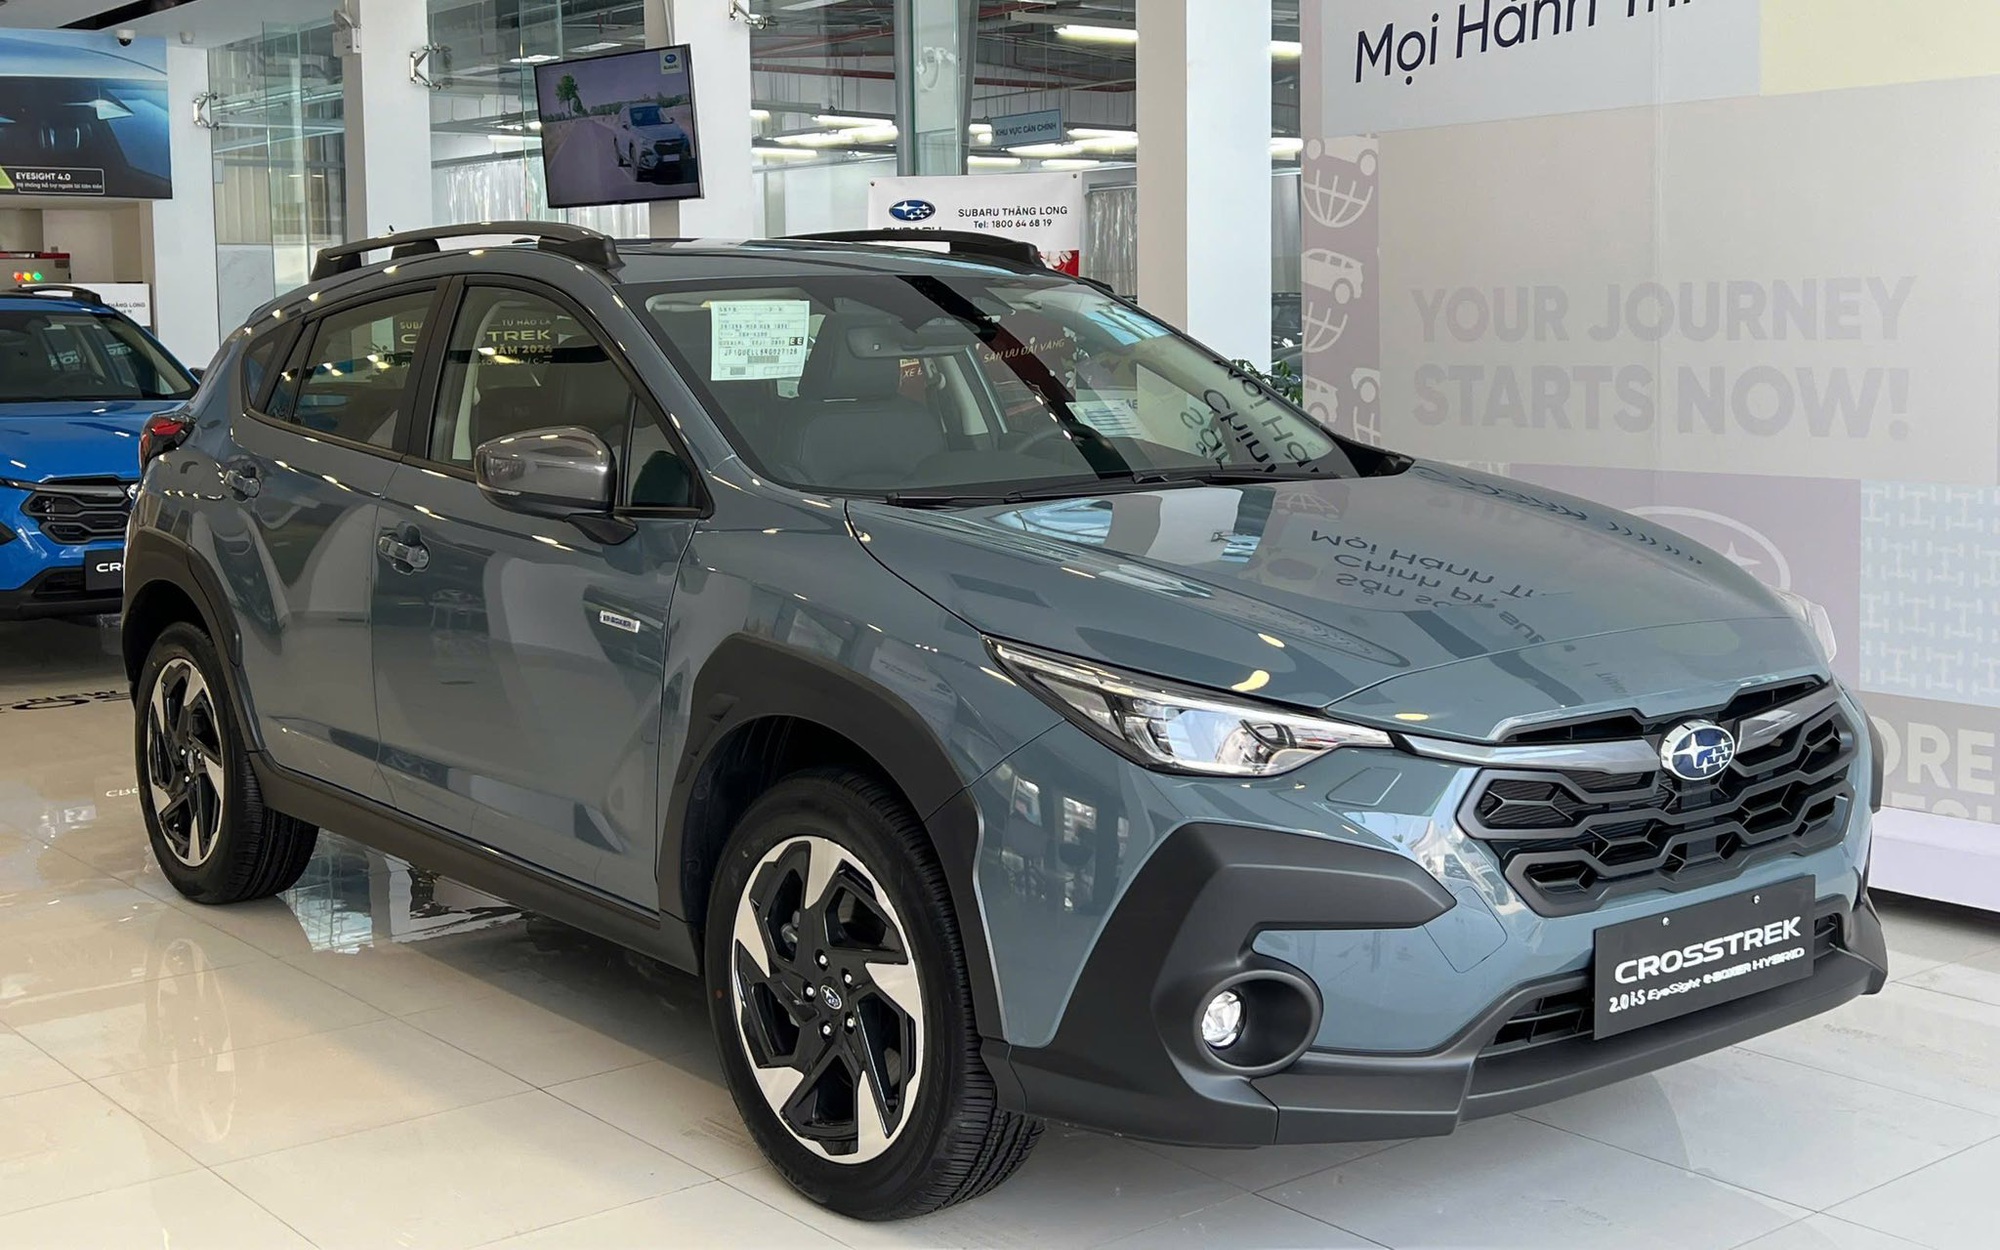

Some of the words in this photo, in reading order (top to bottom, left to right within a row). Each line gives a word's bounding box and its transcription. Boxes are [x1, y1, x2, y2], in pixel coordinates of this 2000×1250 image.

[1355, 13, 1439, 86] Mọi
[16, 172, 55, 180] EYESIGHT
[57, 173, 71, 181] 4.0
[958, 208, 999, 217] SUBARU
[1040, 206, 1068, 215] LONG
[973, 220, 988, 228] Tel:
[991, 219, 1013, 228] 1800
[1016, 220, 1027, 228] 64
[1029, 219, 1040, 227] 68
[1043, 219, 1052, 227] 19
[1411, 285, 1570, 343] YOUR
[1587, 275, 1917, 342] JOURNEY
[1412, 363, 1655, 434] STARTS
[1677, 365, 1911, 441] NOW!
[1609, 993, 1630, 1013] 2.0
[1647, 977, 1702, 1001] EyeSight
[1752, 947, 1805, 971] HYBRID
[1614, 916, 1801, 984] CROSSTREK
